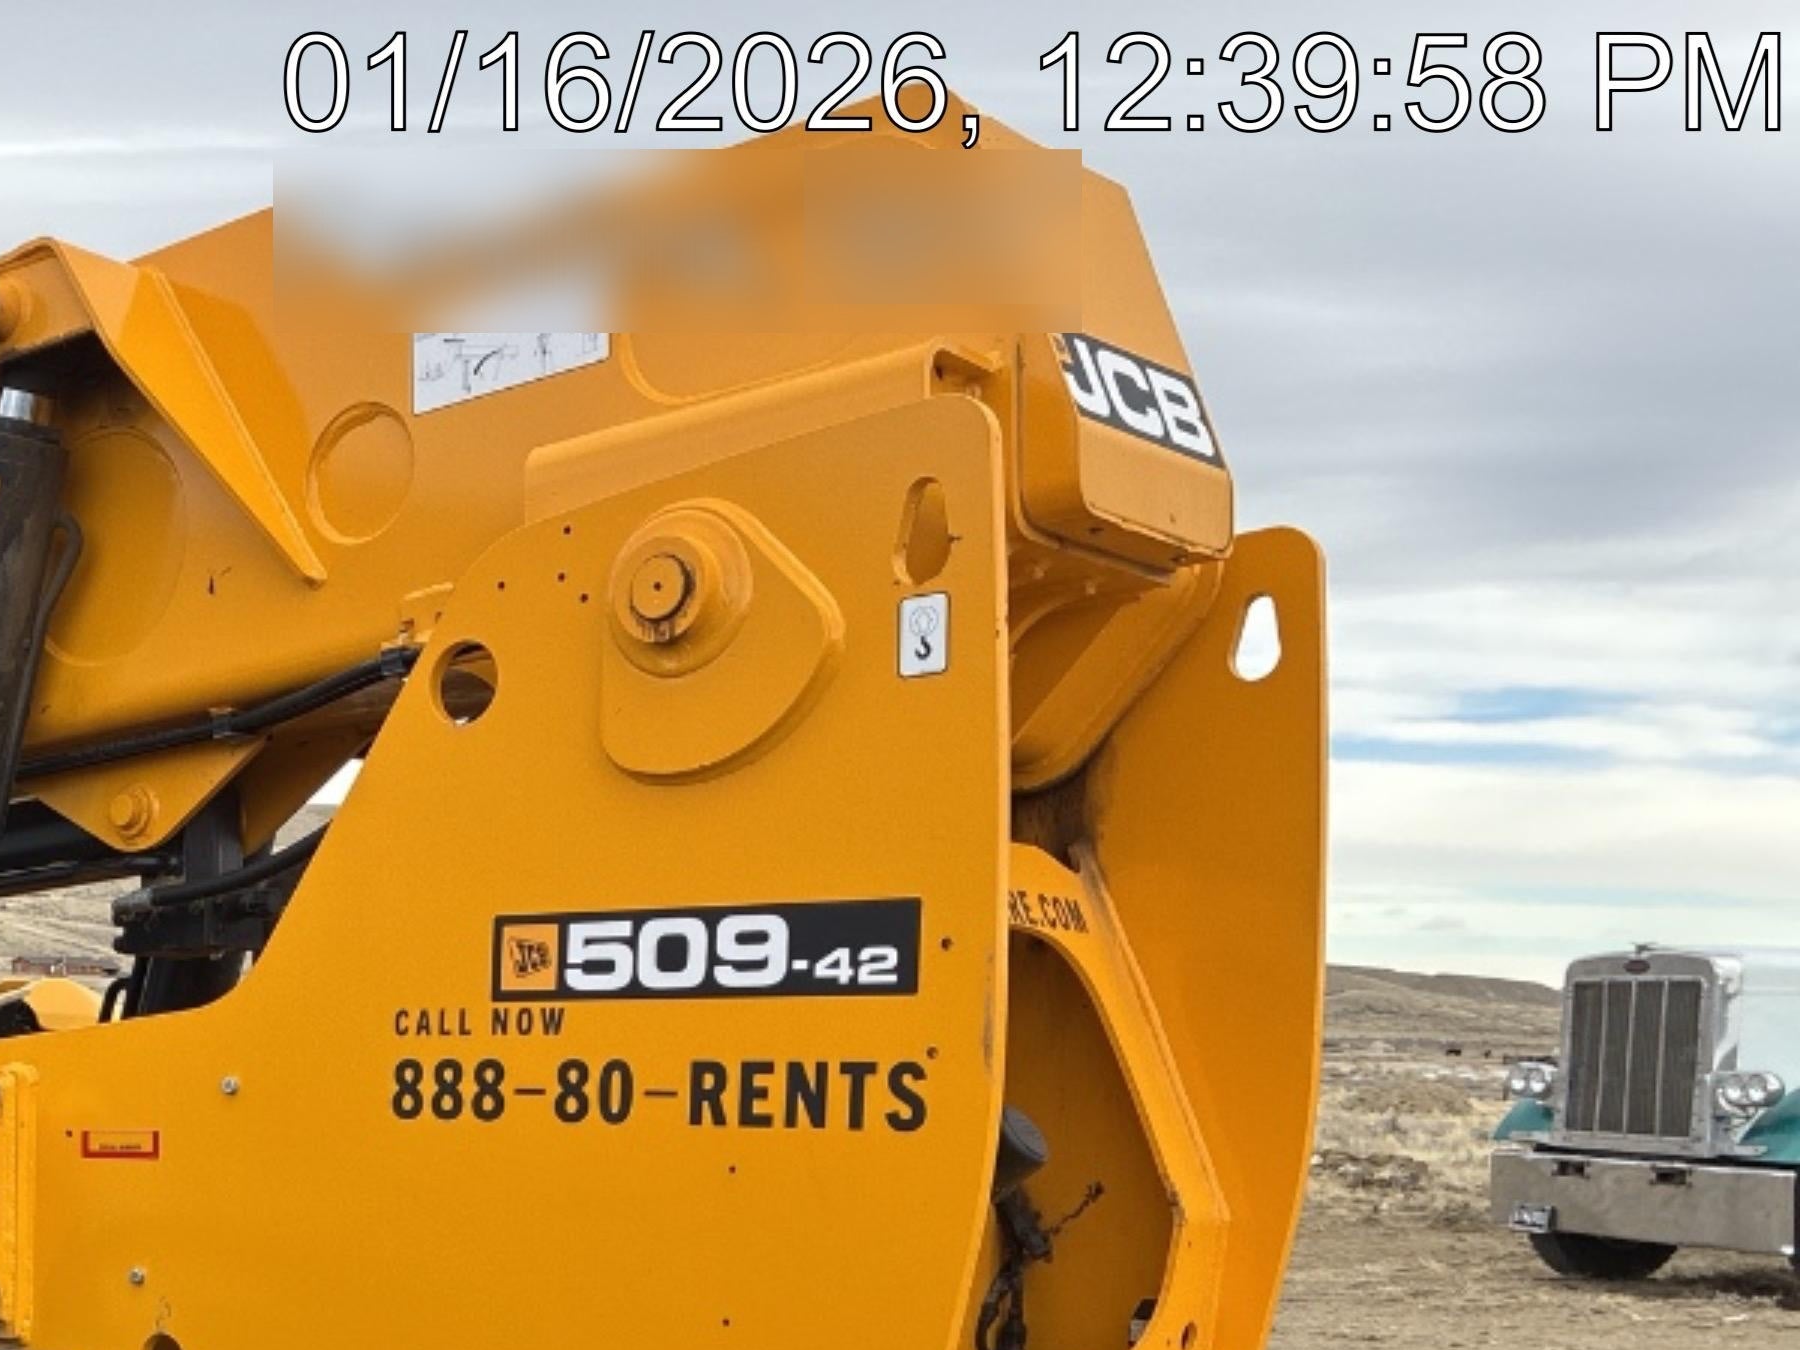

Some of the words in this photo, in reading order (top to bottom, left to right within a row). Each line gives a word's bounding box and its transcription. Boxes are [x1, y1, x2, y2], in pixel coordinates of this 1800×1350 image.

[1065, 337, 1215, 457] JCB
[563, 913, 899, 992] 509-42
[394, 1007, 472, 1037] CALL
[491, 1007, 566, 1036] NOW
[392, 1057, 928, 1133] 888-80-RENTS
